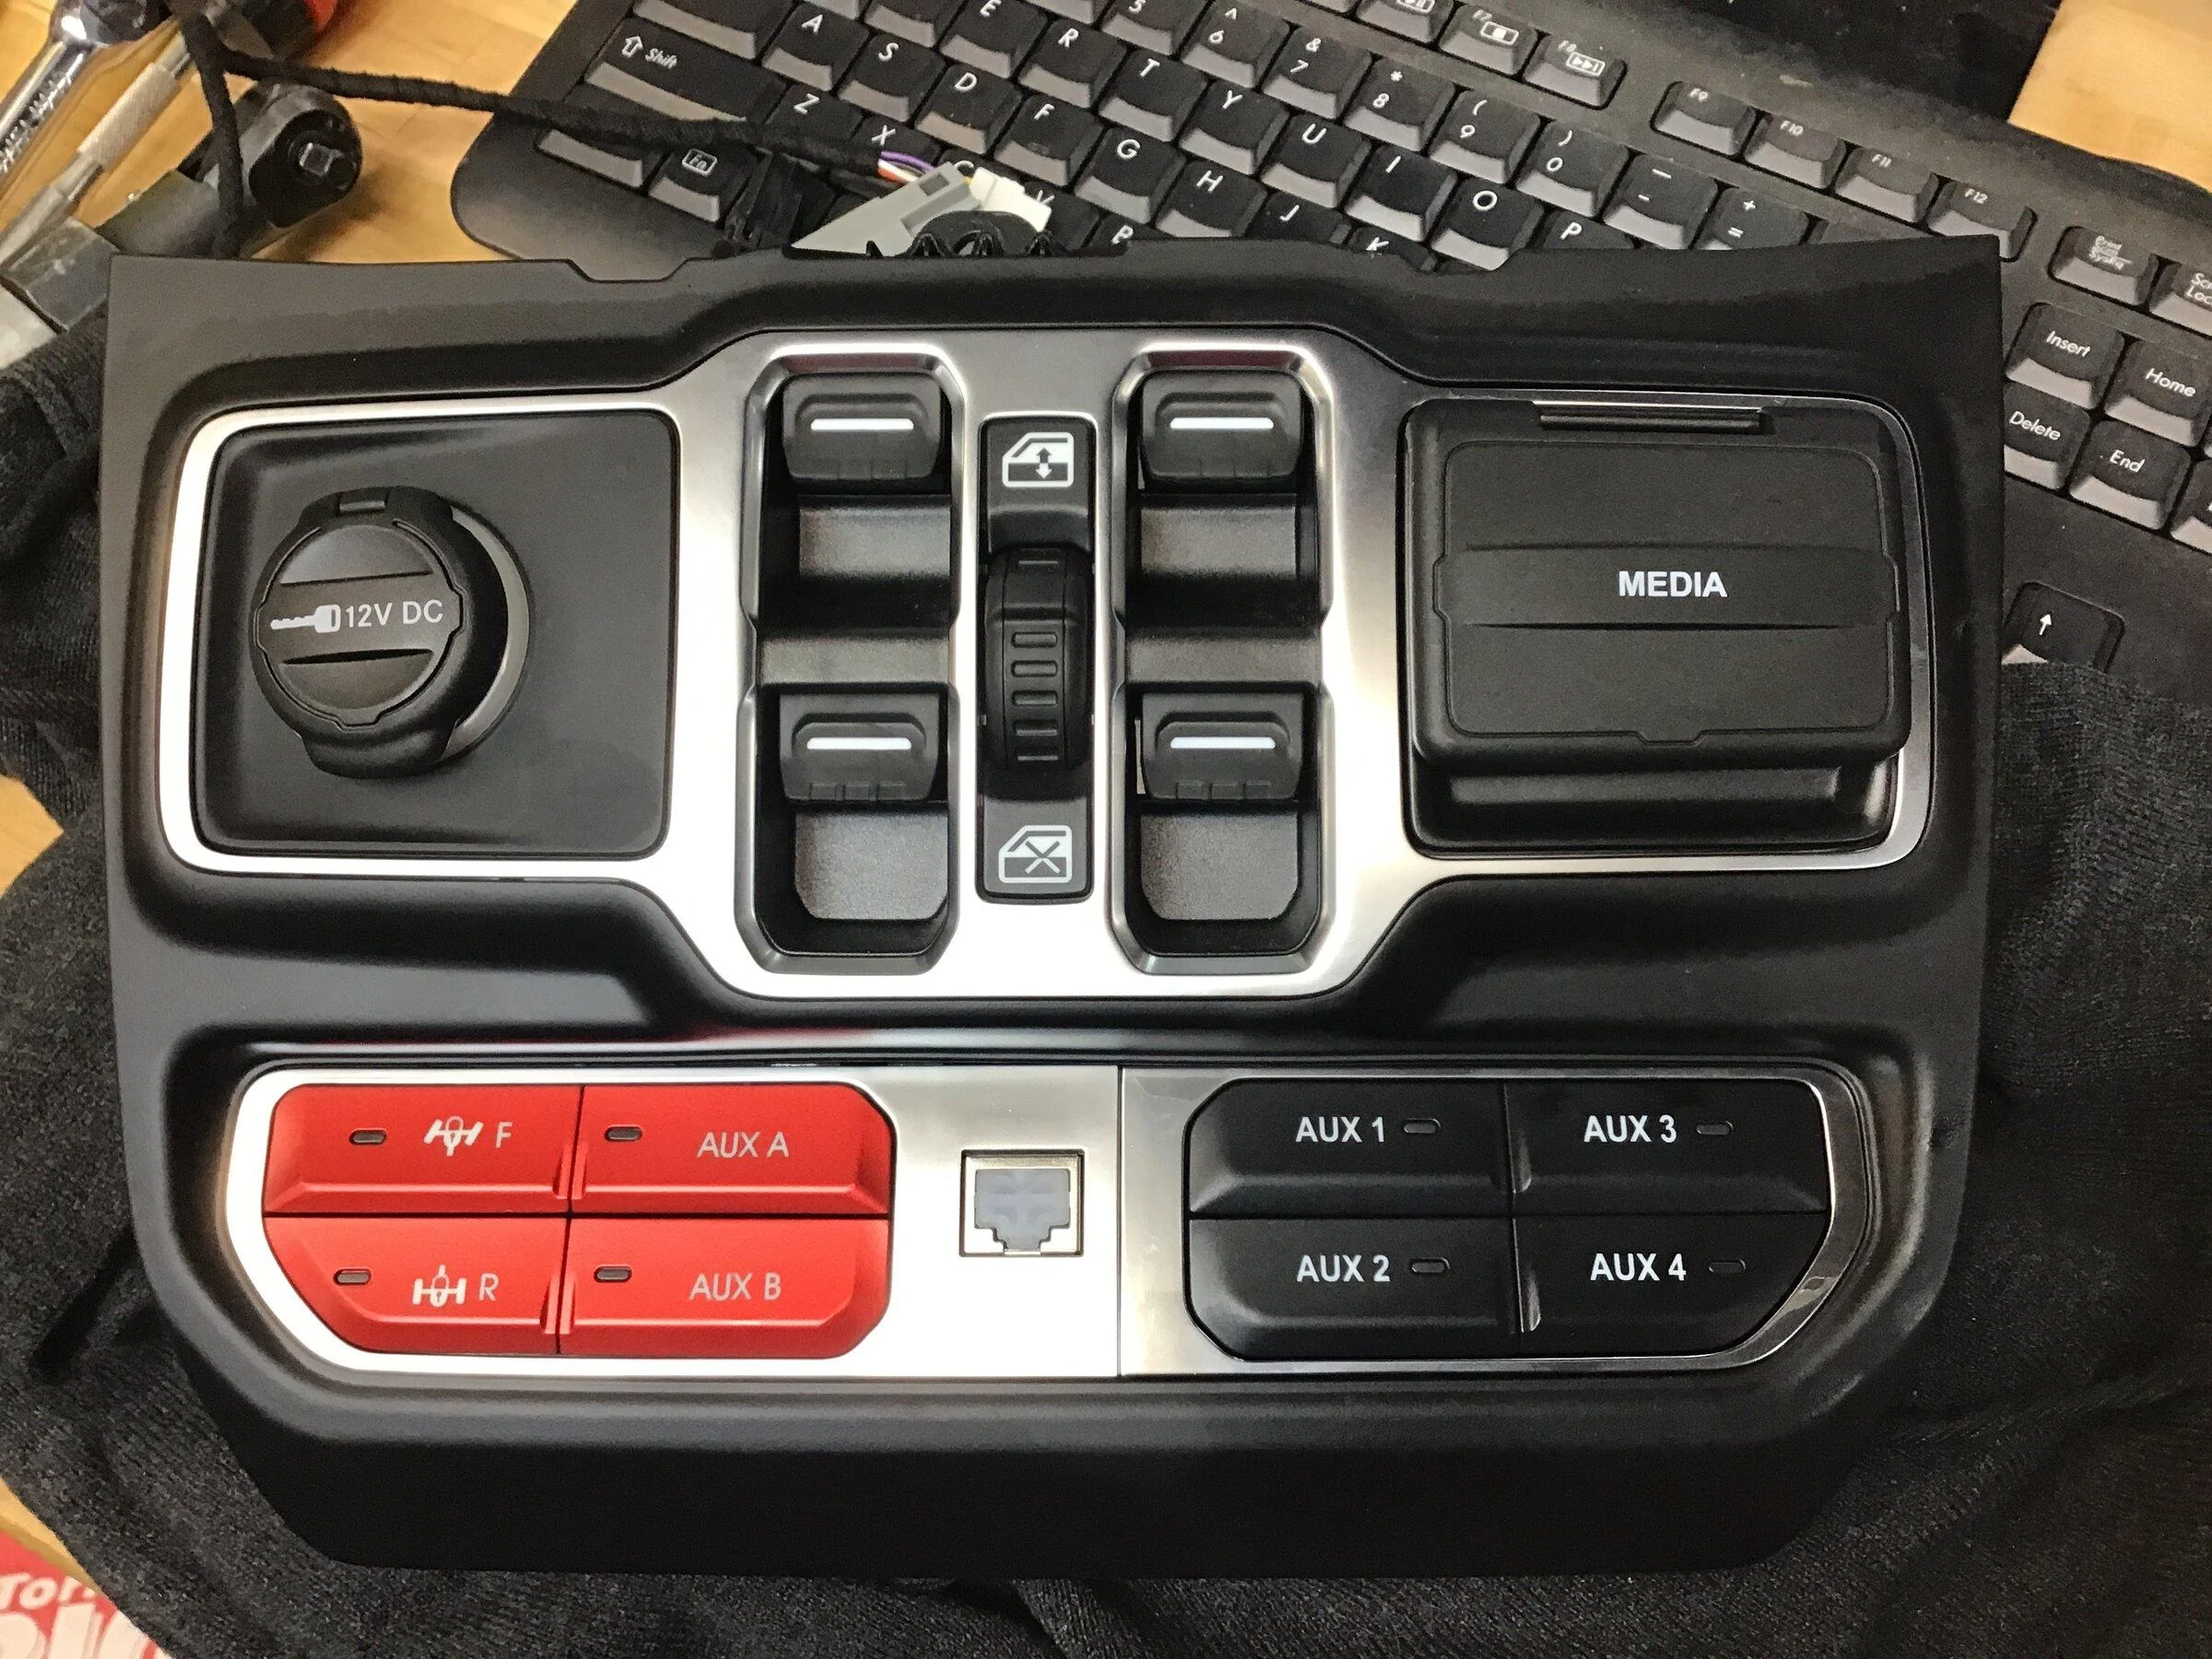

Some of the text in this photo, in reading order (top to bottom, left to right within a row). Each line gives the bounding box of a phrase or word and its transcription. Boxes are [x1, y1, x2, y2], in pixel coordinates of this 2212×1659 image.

[980, 0, 1002, 18] E
[801, 14, 823, 34] A
[1058, 28, 1078, 47] R
[1210, 29, 1224, 44] 6
[645, 48, 677, 68] Shift
[878, 42, 899, 62] S
[1139, 58, 1159, 76] T
[1290, 59, 1309, 74] 7
[954, 72, 977, 92] D
[794, 93, 819, 114] Z
[1222, 89, 1242, 109] Y
[1372, 93, 1390, 109] 8
[1033, 103, 1054, 120] F
[872, 124, 896, 146] X
[1302, 124, 1326, 144] U
[1460, 124, 1475, 139] 9
[1780, 121, 1804, 136] F10
[1116, 139, 1140, 159] G
[1872, 154, 1892, 168] F11
[1196, 170, 1223, 192] H
[1473, 190, 1498, 210] O
[1964, 188, 1988, 205] F12
[1279, 205, 1300, 222] J
[1560, 221, 1583, 240] P
[2045, 330, 2091, 358] Insert
[2145, 368, 2196, 397] Home
[2009, 410, 2062, 441] Delete
[2109, 449, 2146, 473] End
[1618, 571, 1728, 598] MEDIA
[346, 599, 444, 628] 12V DC
[495, 1121, 513, 1148] F
[1295, 1115, 1385, 1144] AUX 1
[1583, 1114, 1677, 1143] AUX 3
[697, 1131, 790, 1159] AUX A
[1296, 1254, 1391, 1282] AUX 2
[1589, 1253, 1687, 1281] AUX 4
[478, 1273, 499, 1301] R
[689, 1272, 782, 1300] AUX B
